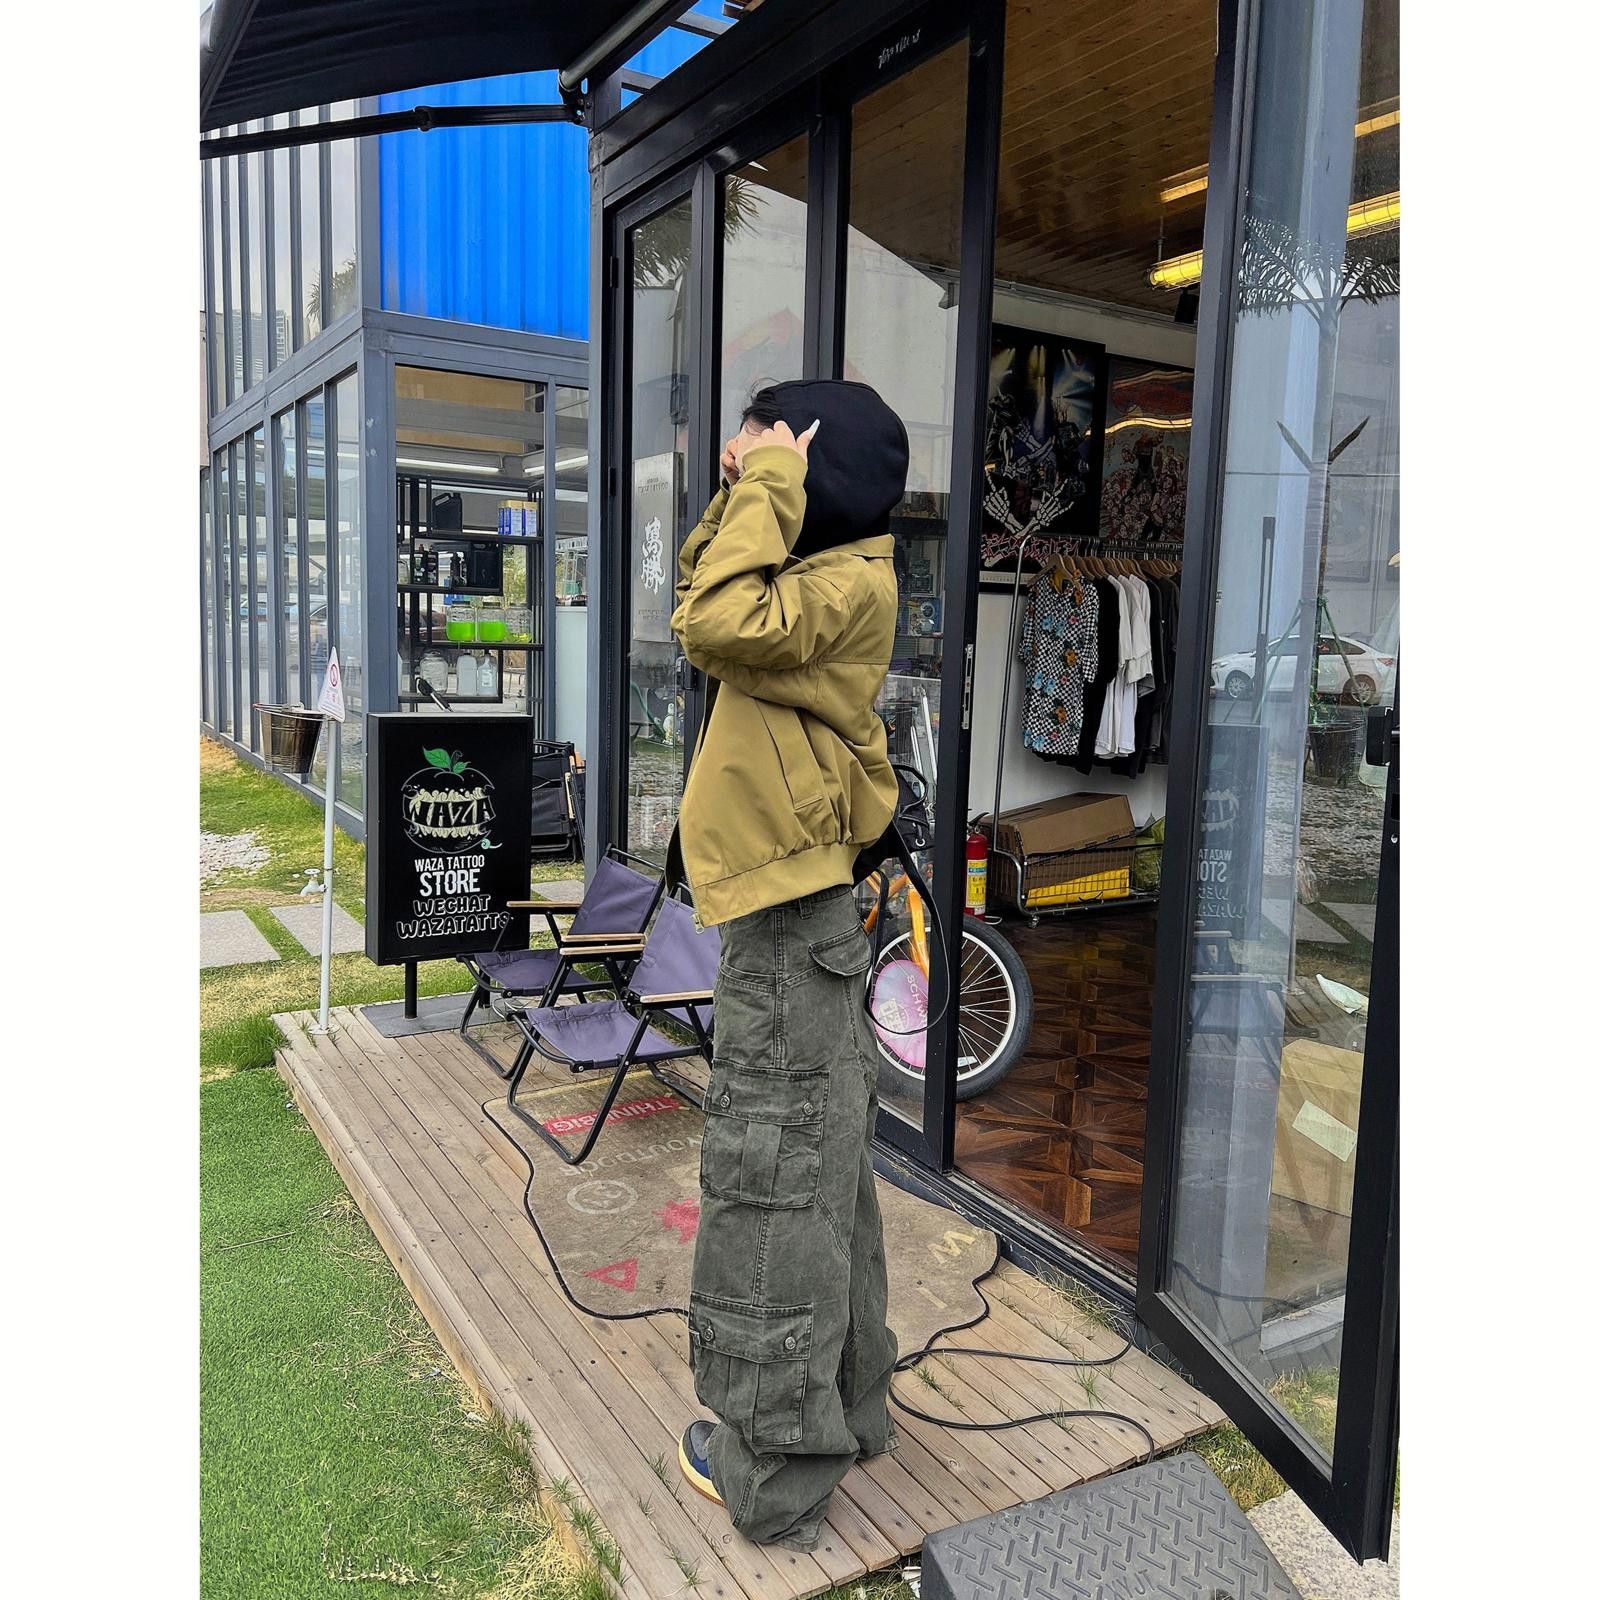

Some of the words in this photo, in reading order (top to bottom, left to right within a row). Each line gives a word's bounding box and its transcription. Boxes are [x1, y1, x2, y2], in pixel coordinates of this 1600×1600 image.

[406, 799, 491, 828] WAZA
[414, 857, 445, 873] WAZA
[446, 854, 485, 870] TATTOO
[420, 868, 481, 897] STORE
[413, 894, 491, 917] WECHAT
